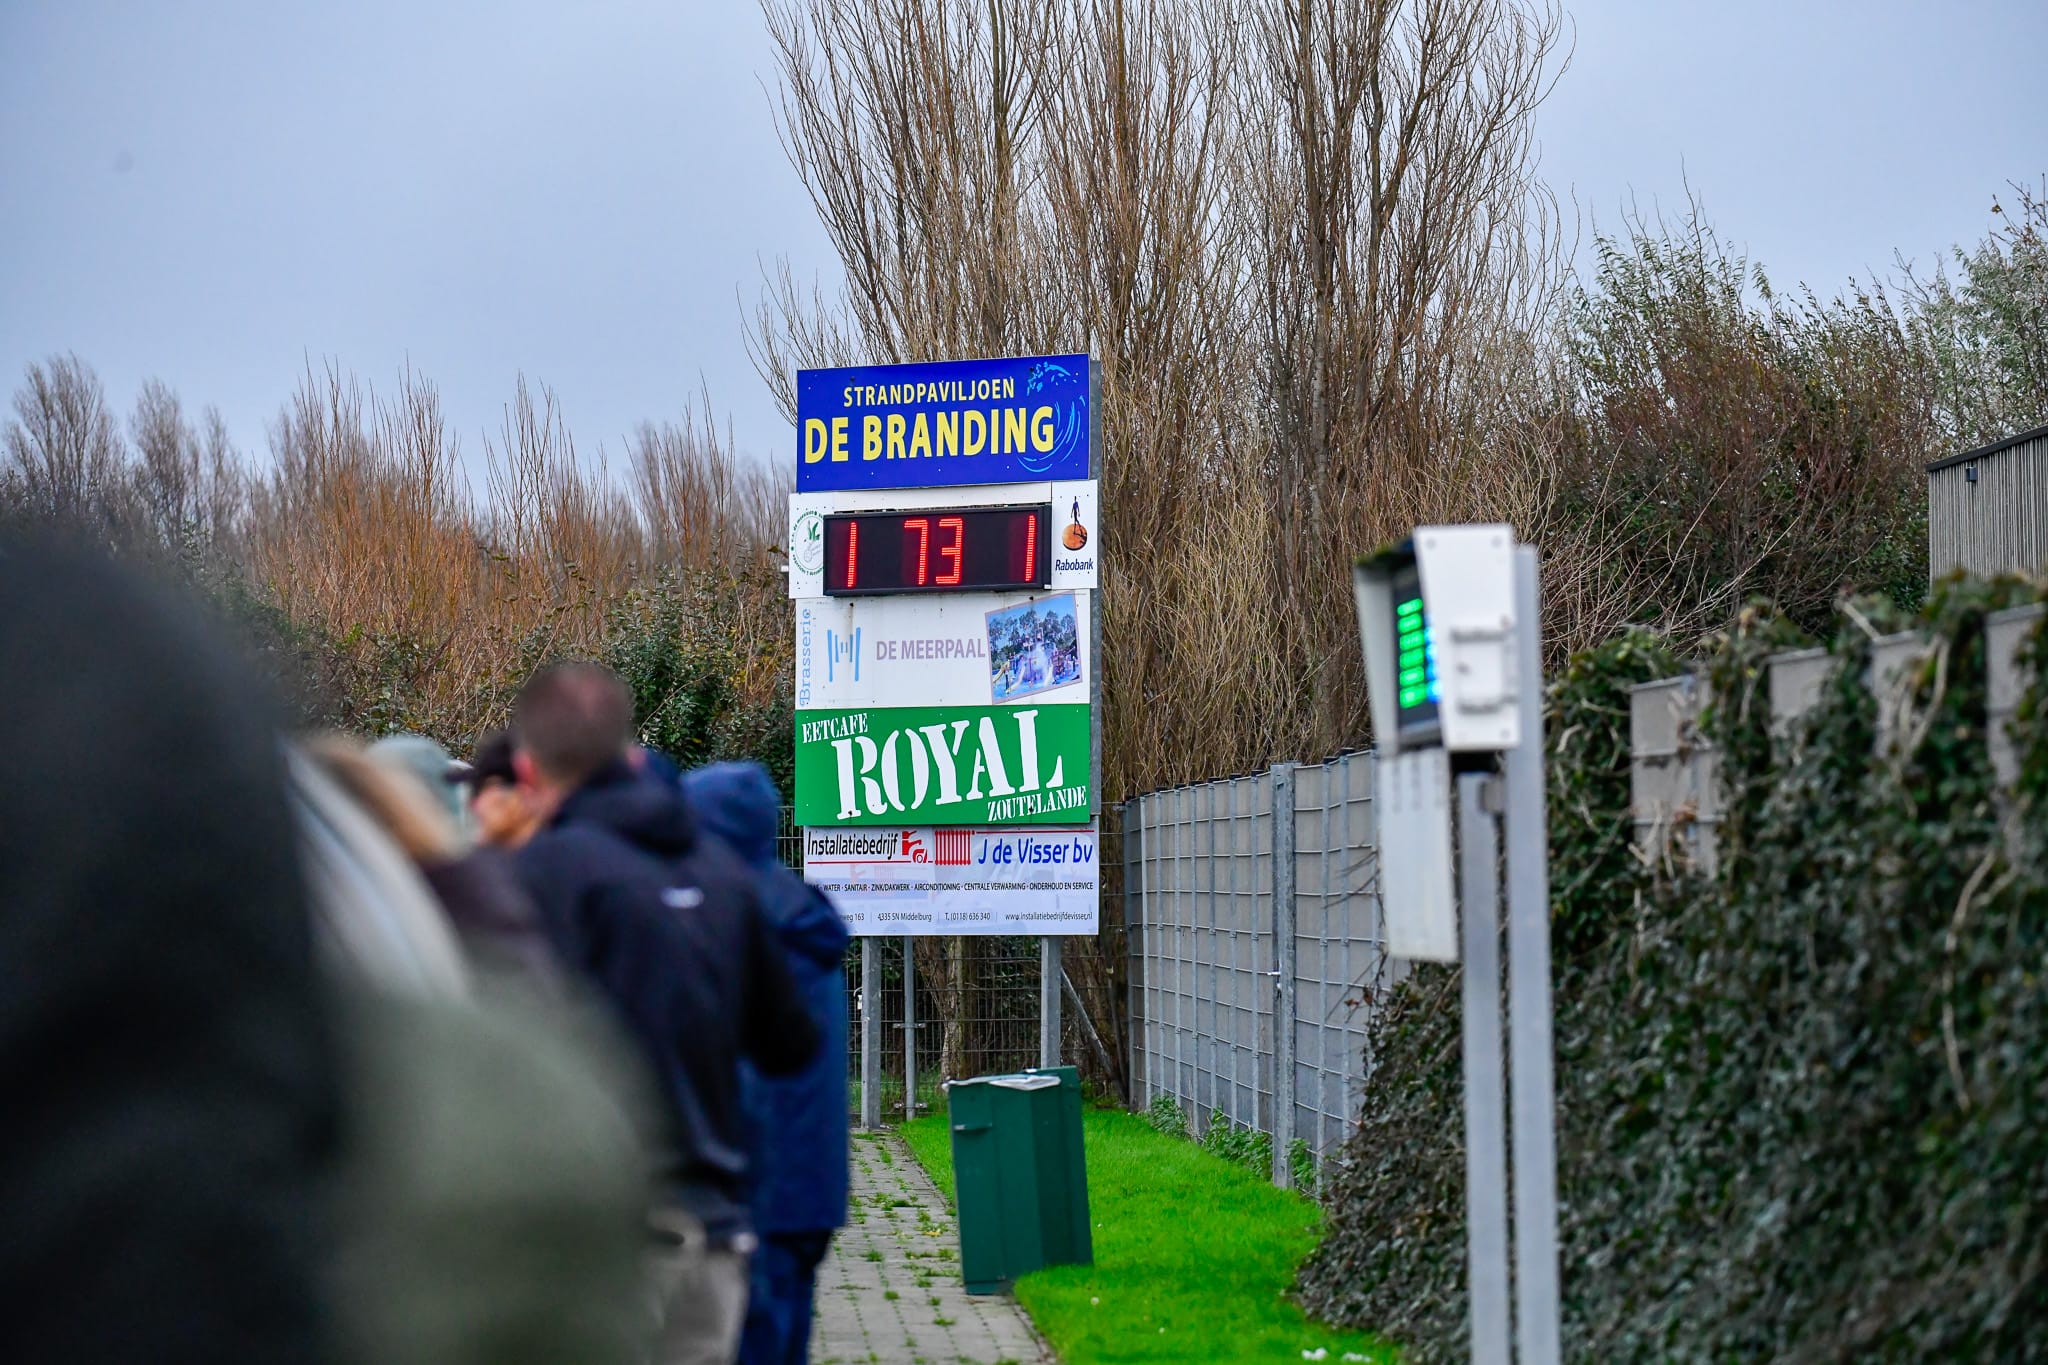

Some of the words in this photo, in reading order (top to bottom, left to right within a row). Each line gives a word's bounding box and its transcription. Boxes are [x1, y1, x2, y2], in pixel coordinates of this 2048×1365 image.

[843, 378, 1015, 407] STRANDPAVILJOEN
[804, 417, 849, 464] DE
[862, 406, 1055, 461] BRANDING
[847, 521, 858, 588] 1
[904, 517, 963, 585] 73
[1025, 514, 1036, 583] 1
[1055, 558, 1094, 571] Rabobank
[799, 608, 812, 707] Brasserie
[876, 641, 897, 661] DE
[901, 638, 986, 660] MEERPAAL
[801, 712, 868, 744] EETCAFE
[830, 709, 1064, 820] ROYAL
[987, 785, 1087, 822] ZOUTELANDE
[807, 831, 899, 860] Installatiebedrijf
[978, 839, 988, 864] J
[992, 837, 1011, 864] de
[1017, 837, 1069, 864] Visser
[1073, 838, 1093, 864] bv
[823, 883, 841, 892] WATER
[844, 883, 868, 892] SANITAIR
[914, 882, 961, 892] AIRCONDITIONING
[964, 882, 990, 891] CENTRALE
[991, 882, 1026, 891] VERWARMING
[1030, 881, 1063, 890] ONDERHOUD
[1064, 881, 1072, 890] EN
[1073, 881, 1093, 890] SERVICE
[855, 912, 865, 921] 163
[892, 912, 900, 921] SN
[900, 912, 932, 922] Middelburg
[980, 912, 991, 921] 340
